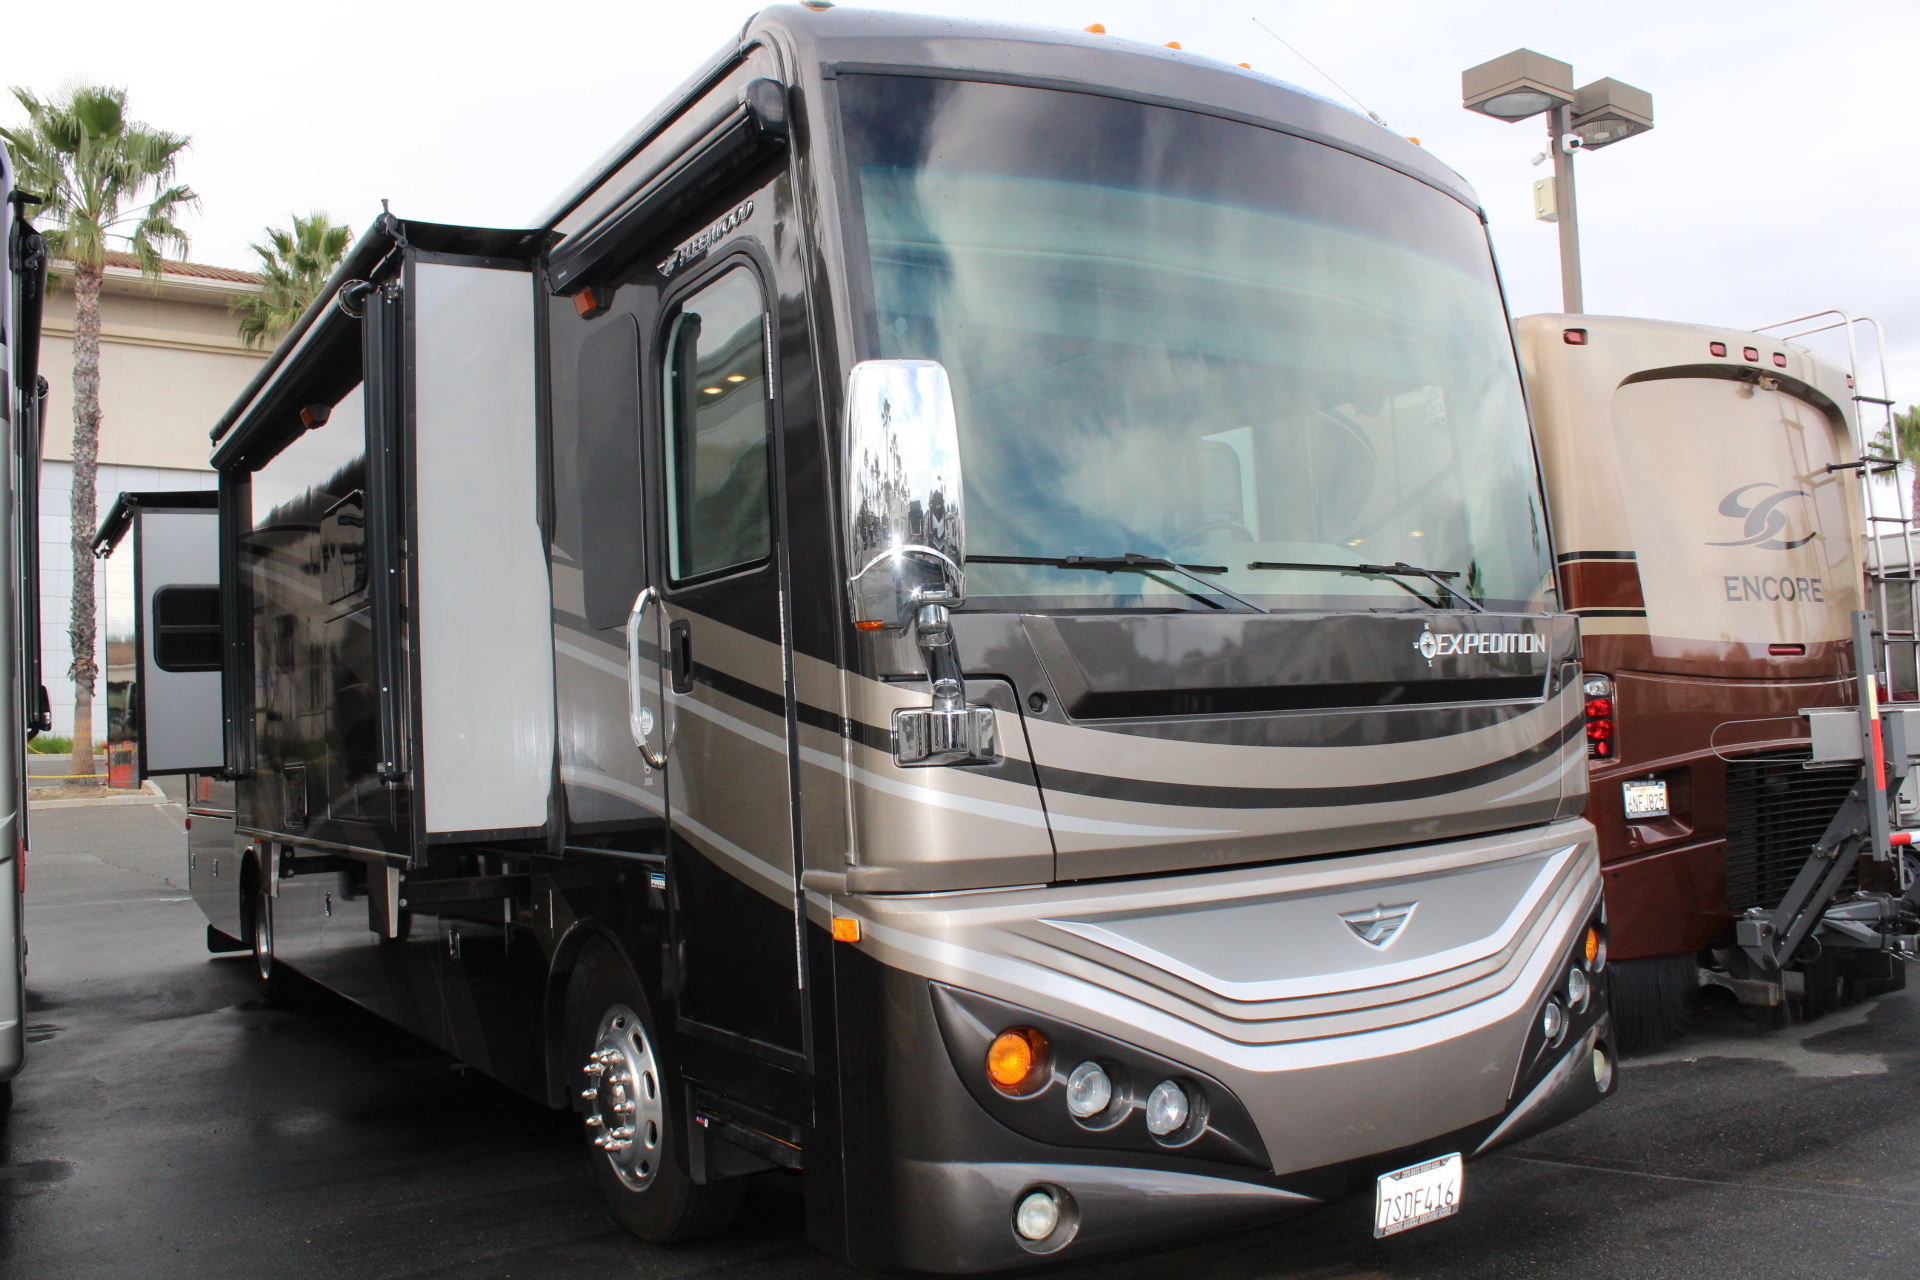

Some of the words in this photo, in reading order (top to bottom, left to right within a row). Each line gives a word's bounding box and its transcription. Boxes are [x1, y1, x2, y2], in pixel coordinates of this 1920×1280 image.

[1723, 576, 1825, 602] ENCORE
[1435, 633, 1546, 655] EXPEDITION
[1383, 1179, 1455, 1227] 7SDF416
